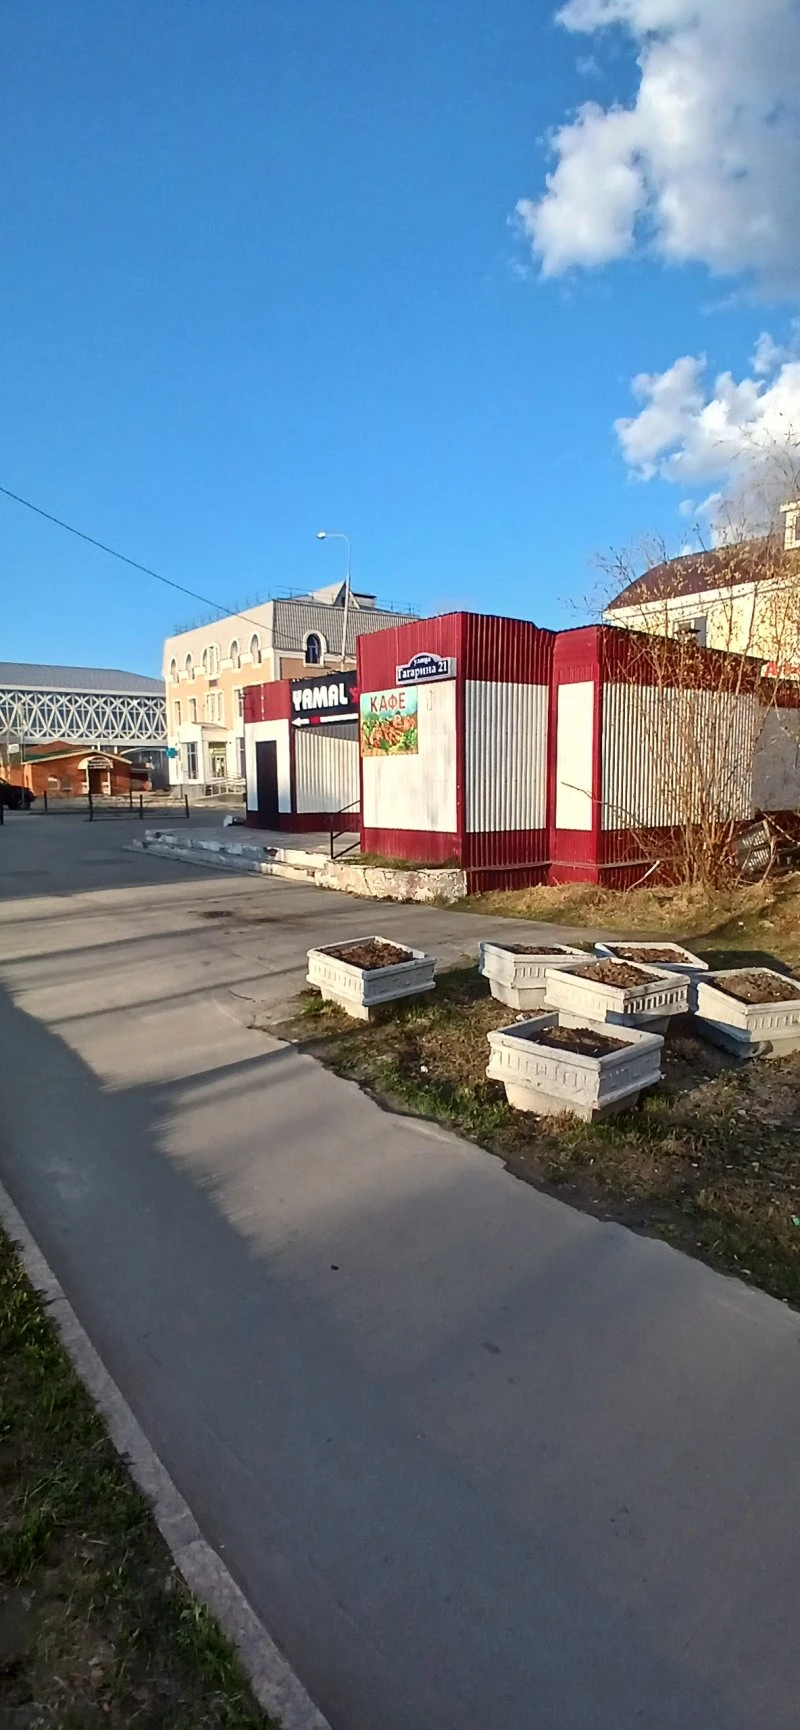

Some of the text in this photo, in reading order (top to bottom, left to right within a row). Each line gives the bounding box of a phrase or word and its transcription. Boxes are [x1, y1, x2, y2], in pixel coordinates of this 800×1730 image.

[398, 661, 447, 680] Гагарина 21
[292, 683, 348, 711] YAMAL
[370, 692, 405, 712] КАФЕ
